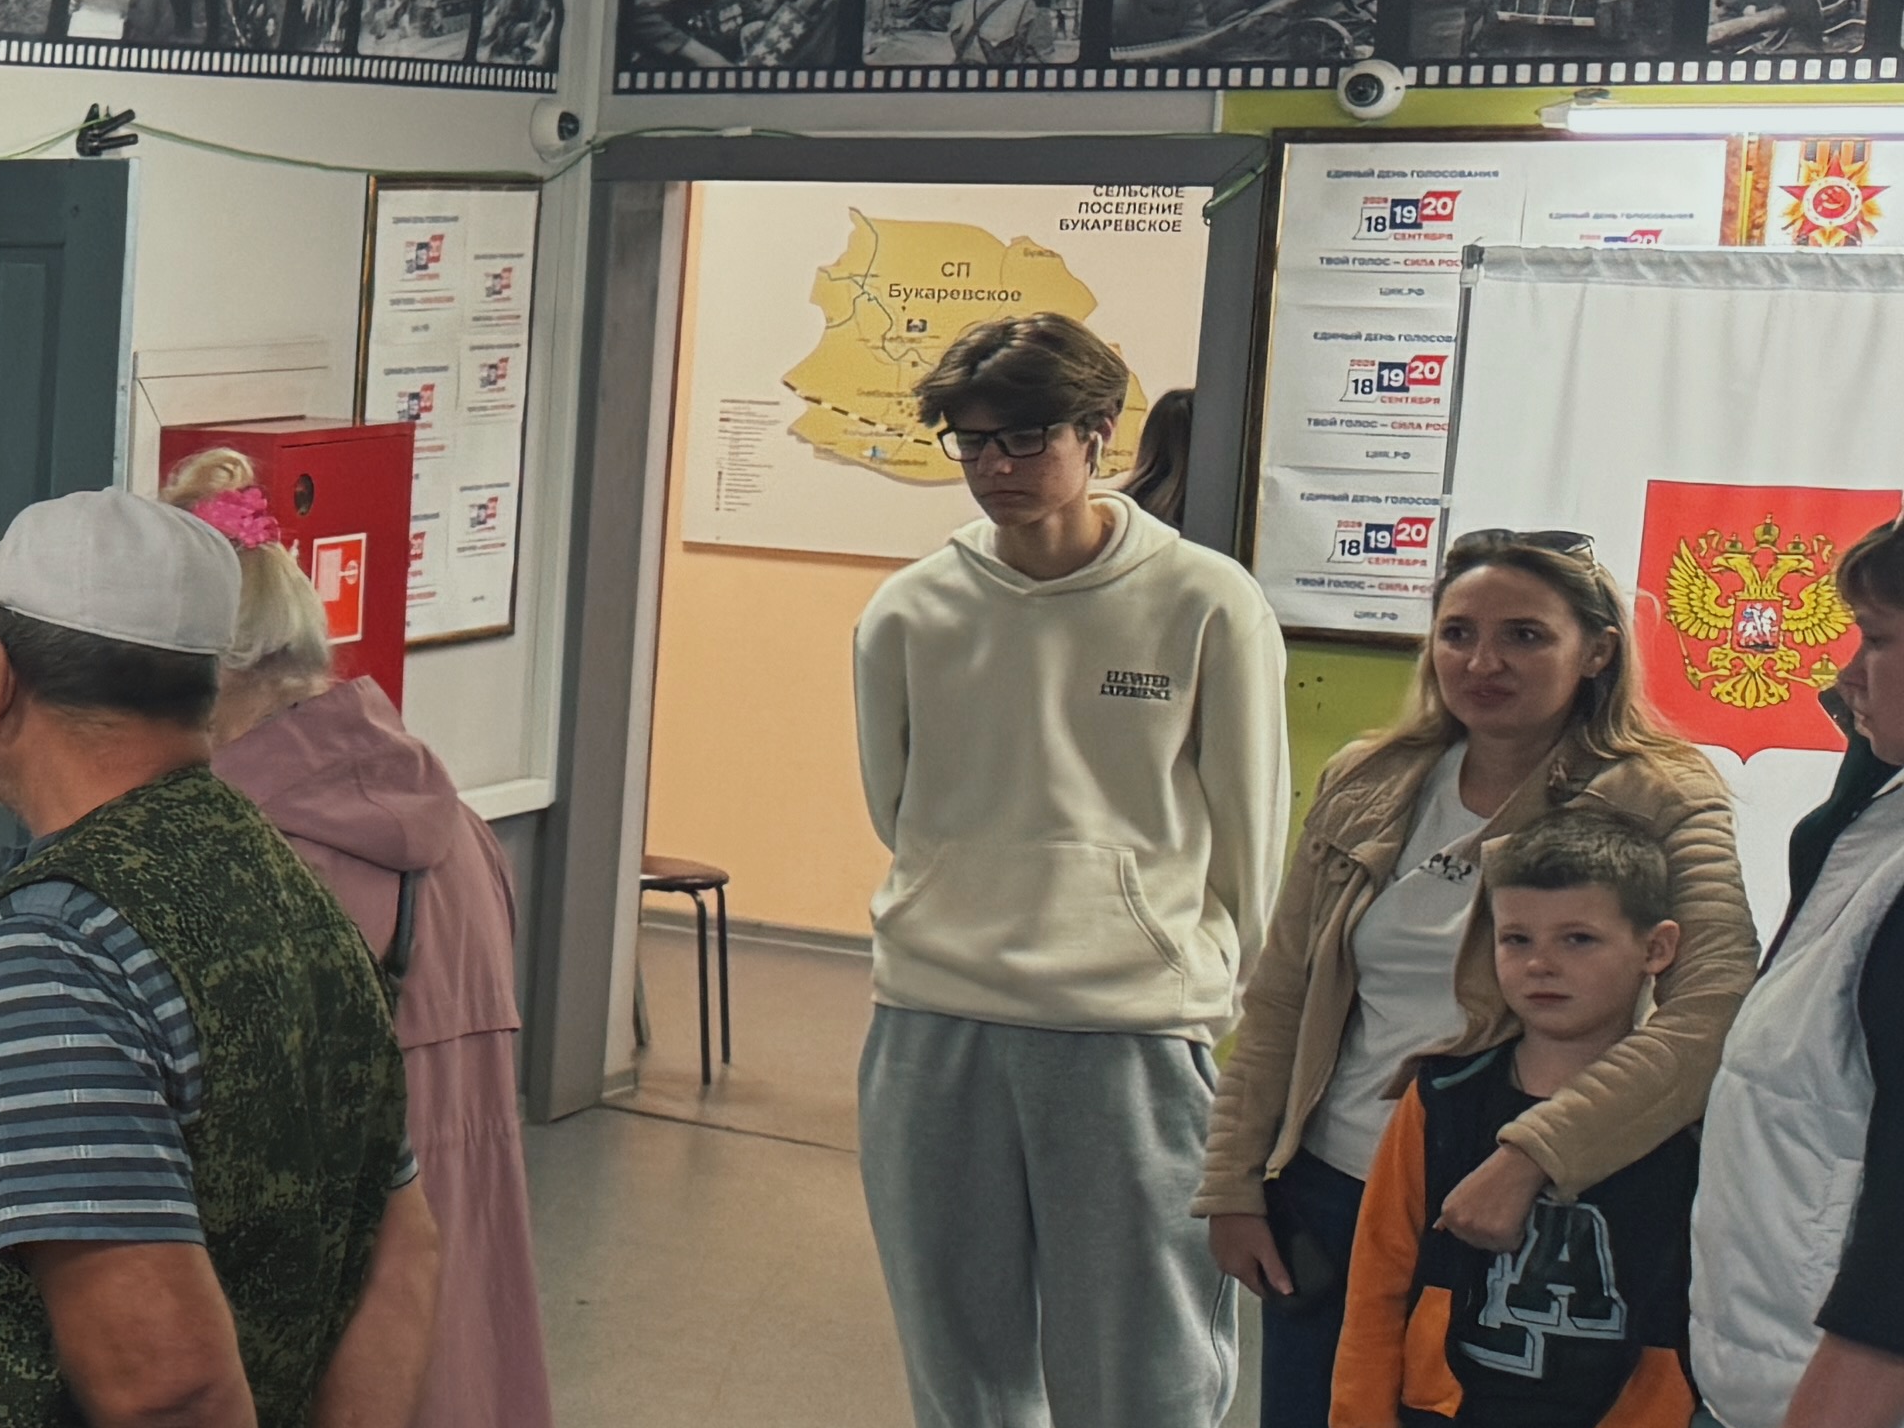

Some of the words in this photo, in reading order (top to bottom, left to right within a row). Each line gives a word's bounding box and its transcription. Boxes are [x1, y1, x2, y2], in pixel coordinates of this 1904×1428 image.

[1093, 184, 1185, 198] СЕЛЬСКОЕ
[1078, 201, 1184, 216] ПОСЕЛЕНИЕ
[1364, 215, 1387, 233] 18
[1393, 205, 1417, 224] 19
[1422, 197, 1453, 216] 20
[1059, 218, 1182, 232] БУКАРЕВСКОЕ
[1319, 255, 1350, 266] ТВОЙ
[1352, 257, 1391, 267] ГОЛОС
[1404, 257, 1435, 267] СИЛА
[1438, 258, 1462, 268] РОС
[940, 262, 971, 278] СП
[888, 283, 1022, 304] Букаревское
[1398, 333, 1457, 343] ГОЛОСОВ
[1351, 378, 1374, 395] 18
[1380, 368, 1404, 387] 19
[1409, 361, 1440, 380] 20
[1307, 417, 1337, 427] ТВОЙ
[1339, 418, 1378, 429] ГОЛОС
[1425, 422, 1449, 432] РОС
[1385, 495, 1440, 506] ГОЛОСОВ
[1338, 538, 1361, 556] 18
[1366, 529, 1391, 549] 19
[1396, 523, 1427, 542] 20
